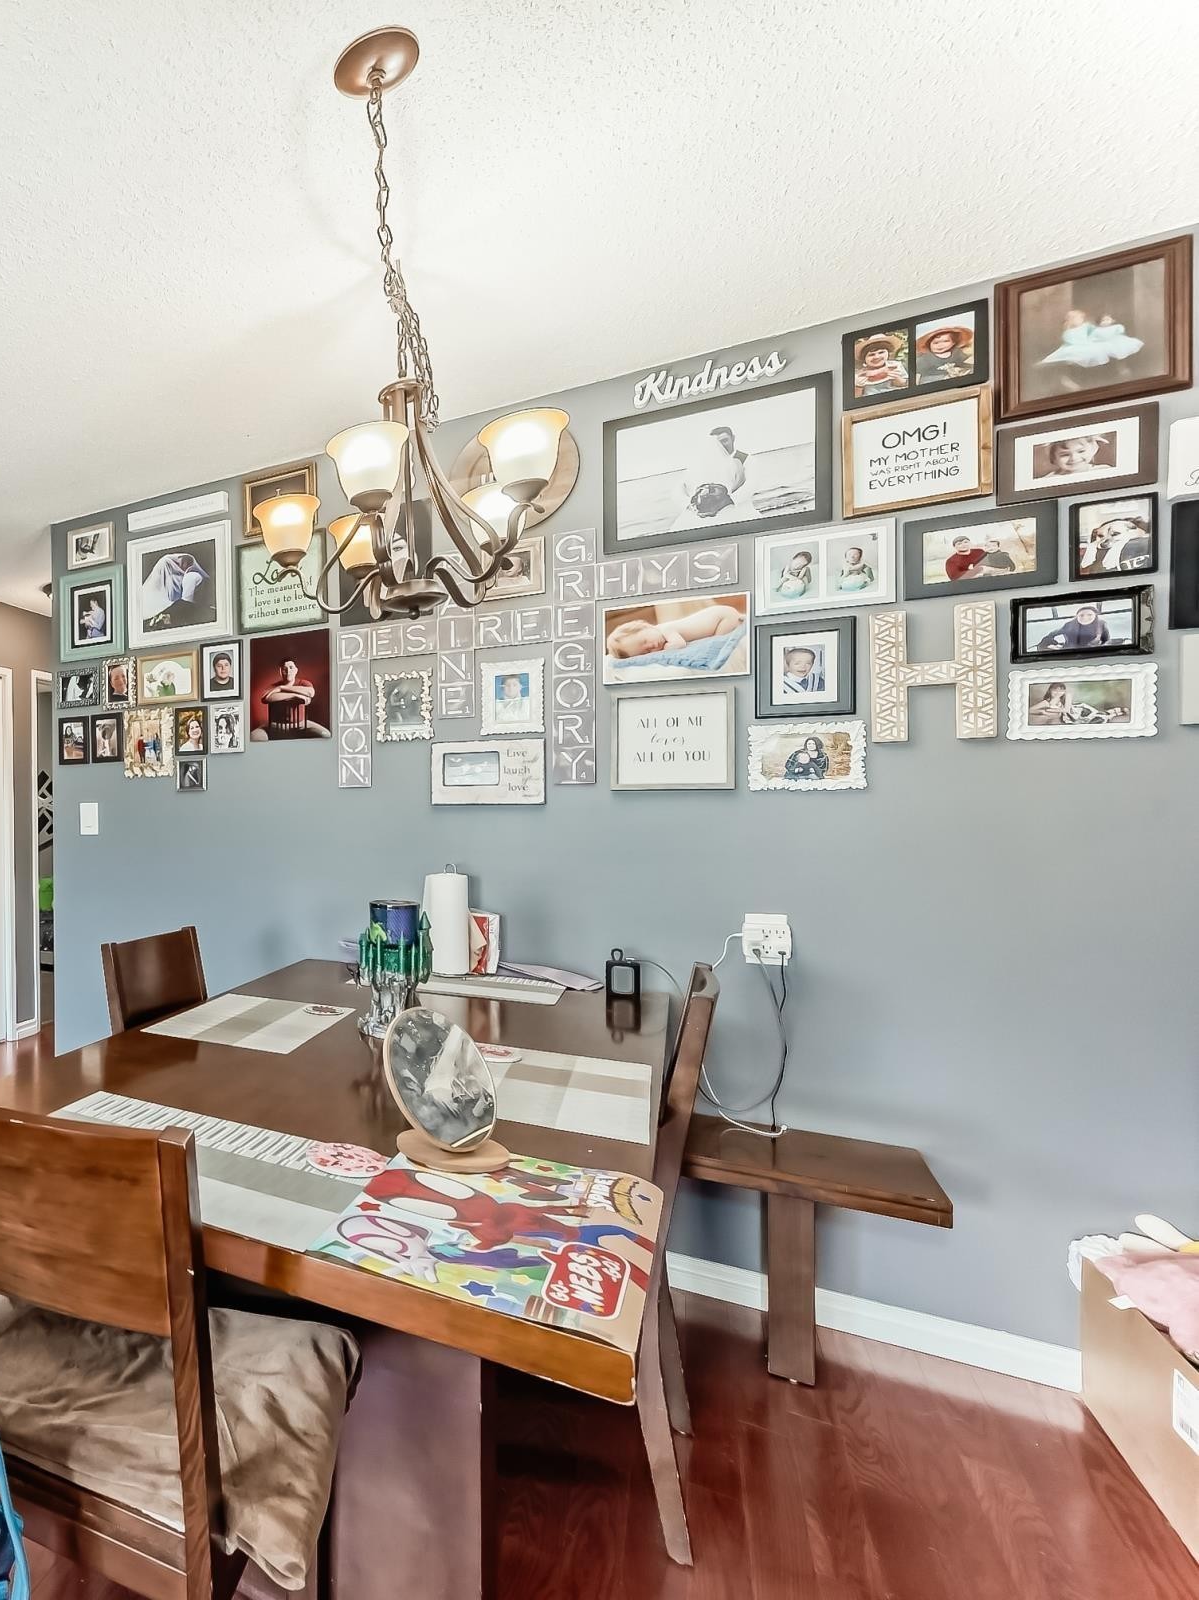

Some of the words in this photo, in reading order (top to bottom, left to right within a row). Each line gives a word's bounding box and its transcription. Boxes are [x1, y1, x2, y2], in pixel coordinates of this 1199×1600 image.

[634, 352, 786, 408] Kindness
[882, 422, 946, 449] OMG!
[870, 456, 889, 467] MY
[895, 442, 959, 462] MOTHER
[870, 467, 891, 476] WAS
[895, 462, 920, 472] RIGHT
[925, 455, 959, 467] ABOUT
[869, 466, 959, 489] EVERYTHING
[253, 560, 304, 585] Lo
[558, 551, 720, 600] RHYS
[249, 586, 264, 597] The
[268, 583, 301, 594] measure
[249, 608, 279, 619] without
[282, 603, 318, 613] measure.
[255, 597, 271, 607] love
[555, 535, 585, 780] GREGORY
[340, 634, 366, 784] DAMON
[506, 749, 527, 758] Live
[685, 750, 711, 761] YOU
[503, 766, 530, 776] laugh
[508, 783, 529, 791] love
[568, 1252, 604, 1306] WEBS
